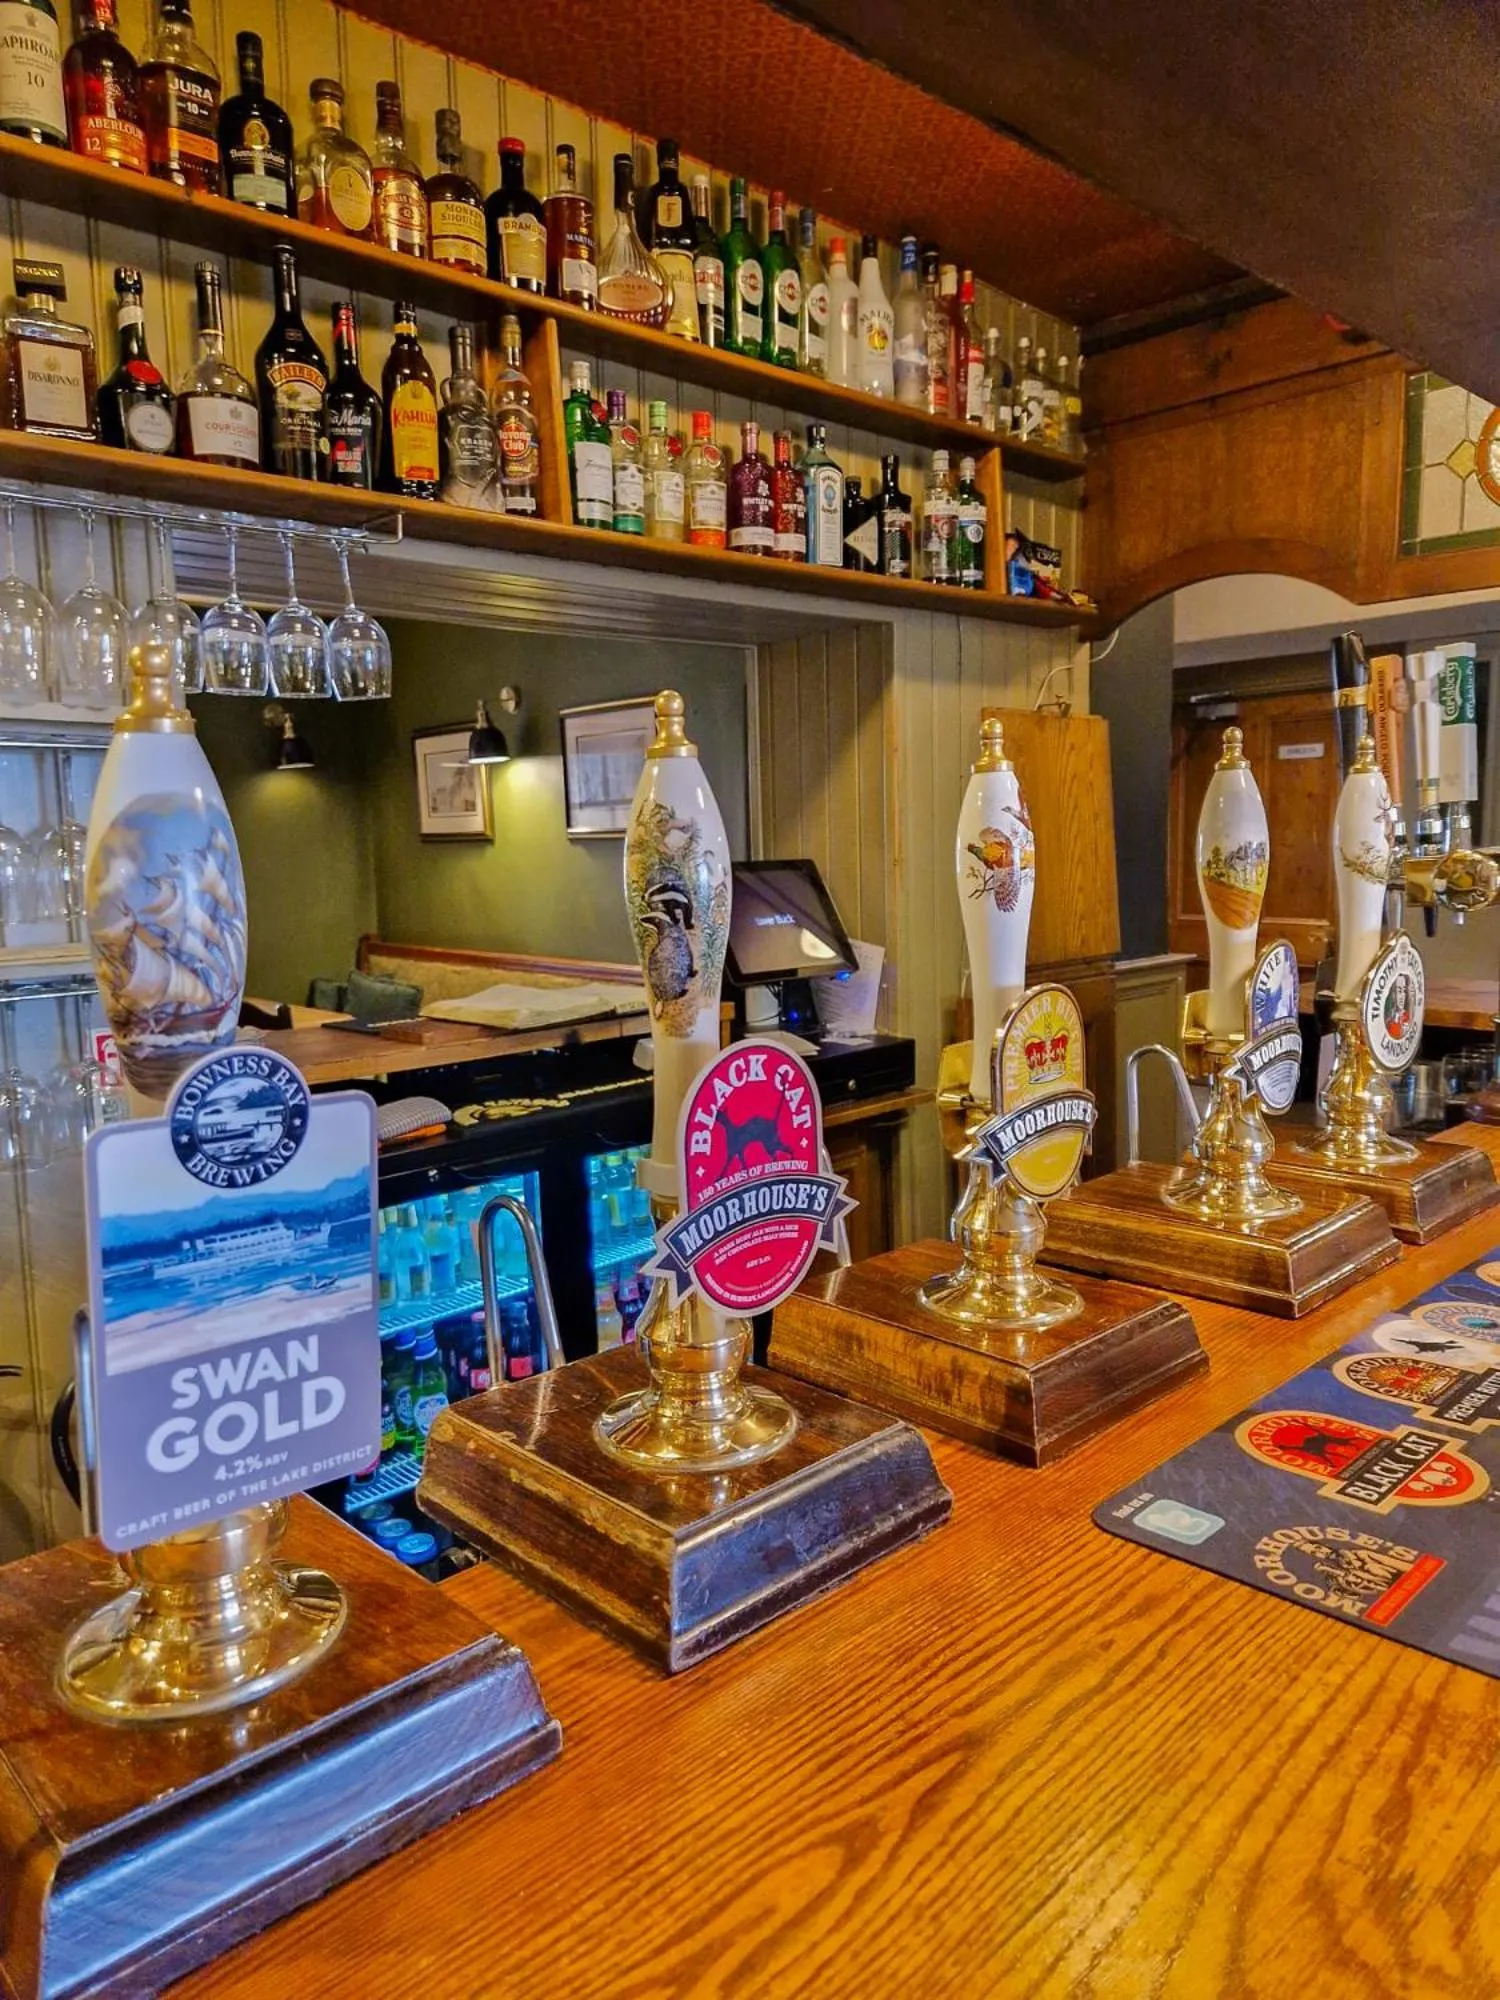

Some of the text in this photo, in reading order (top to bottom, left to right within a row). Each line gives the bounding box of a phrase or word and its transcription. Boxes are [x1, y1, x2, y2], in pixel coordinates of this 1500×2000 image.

[27, 71, 45, 88] 10
[168, 77, 213, 103] JURA
[86, 136, 101, 151] 12
[87, 117, 144, 140] ABERLOUR
[271, 365, 323, 389] BAILEYS
[1441, 661, 1460, 722] Carlsberg
[1255, 951, 1282, 1014] WHITE
[1371, 955, 1397, 1021] TIMOTHY
[1380, 1021, 1417, 1058] LANDLORD
[175, 1055, 307, 1121] BOWNESS BAY
[690, 1054, 812, 1156] BLACK CAT
[185, 1137, 297, 1187] BREWING
[715, 1169, 748, 1191] YEARS
[749, 1164, 762, 1177] OF
[764, 1159, 809, 1175] BREWING
[678, 1183, 830, 1257] MOORHOUSE'S
[170, 1334, 319, 1410] SWAN
[146, 1375, 346, 1473] GOLD
[116, 1444, 373, 1539] CRAFT BEER OF THE LAKE DISTRICT
[1345, 1460, 1415, 1501] BLACK
[1397, 1435, 1440, 1467] CAT
[1254, 1525, 1420, 1618] MOORHOUSE'S
